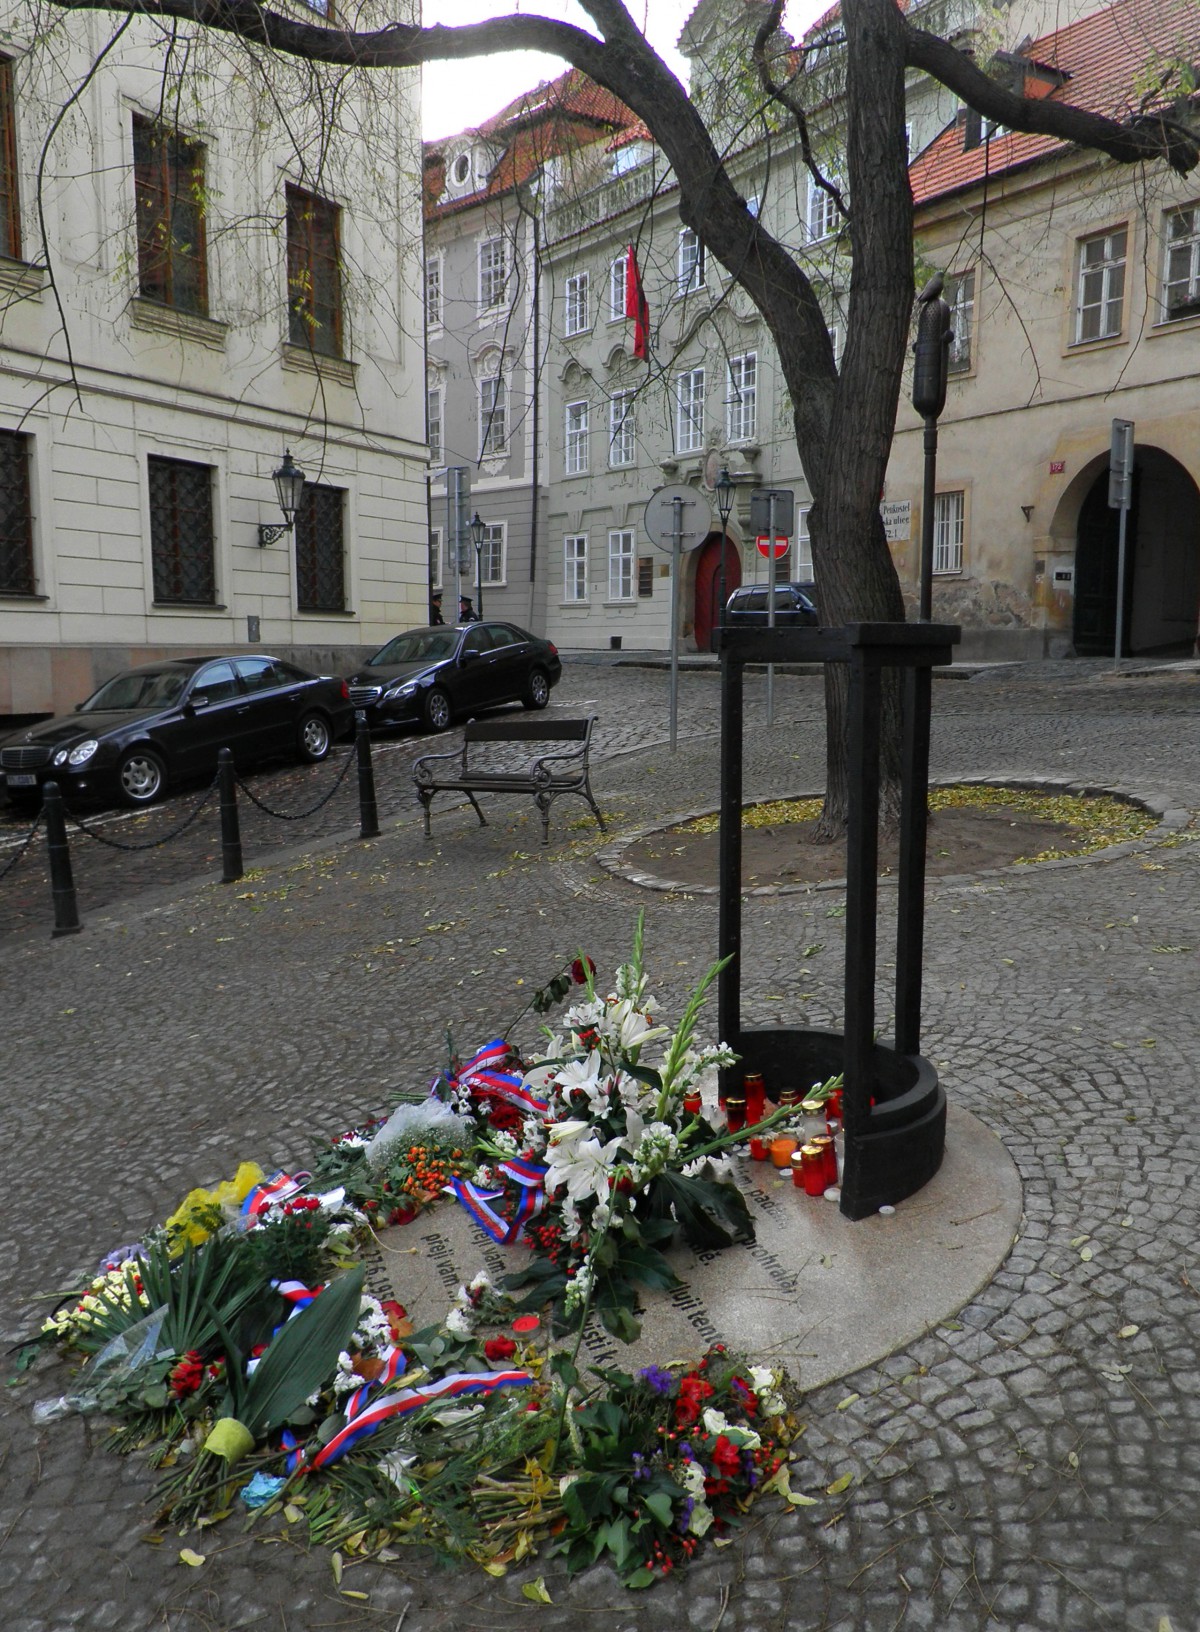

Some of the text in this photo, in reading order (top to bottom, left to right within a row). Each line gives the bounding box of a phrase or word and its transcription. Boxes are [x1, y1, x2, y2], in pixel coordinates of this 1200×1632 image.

[1052, 463, 1062, 471] 172
[893, 516, 910, 525] ulice
[420, 1233, 455, 1260] přeji
[482, 1246, 508, 1274] vám
[359, 1249, 395, 1302] 27.6.195
[436, 1259, 461, 1288] vám
[593, 1349, 618, 1365] k
